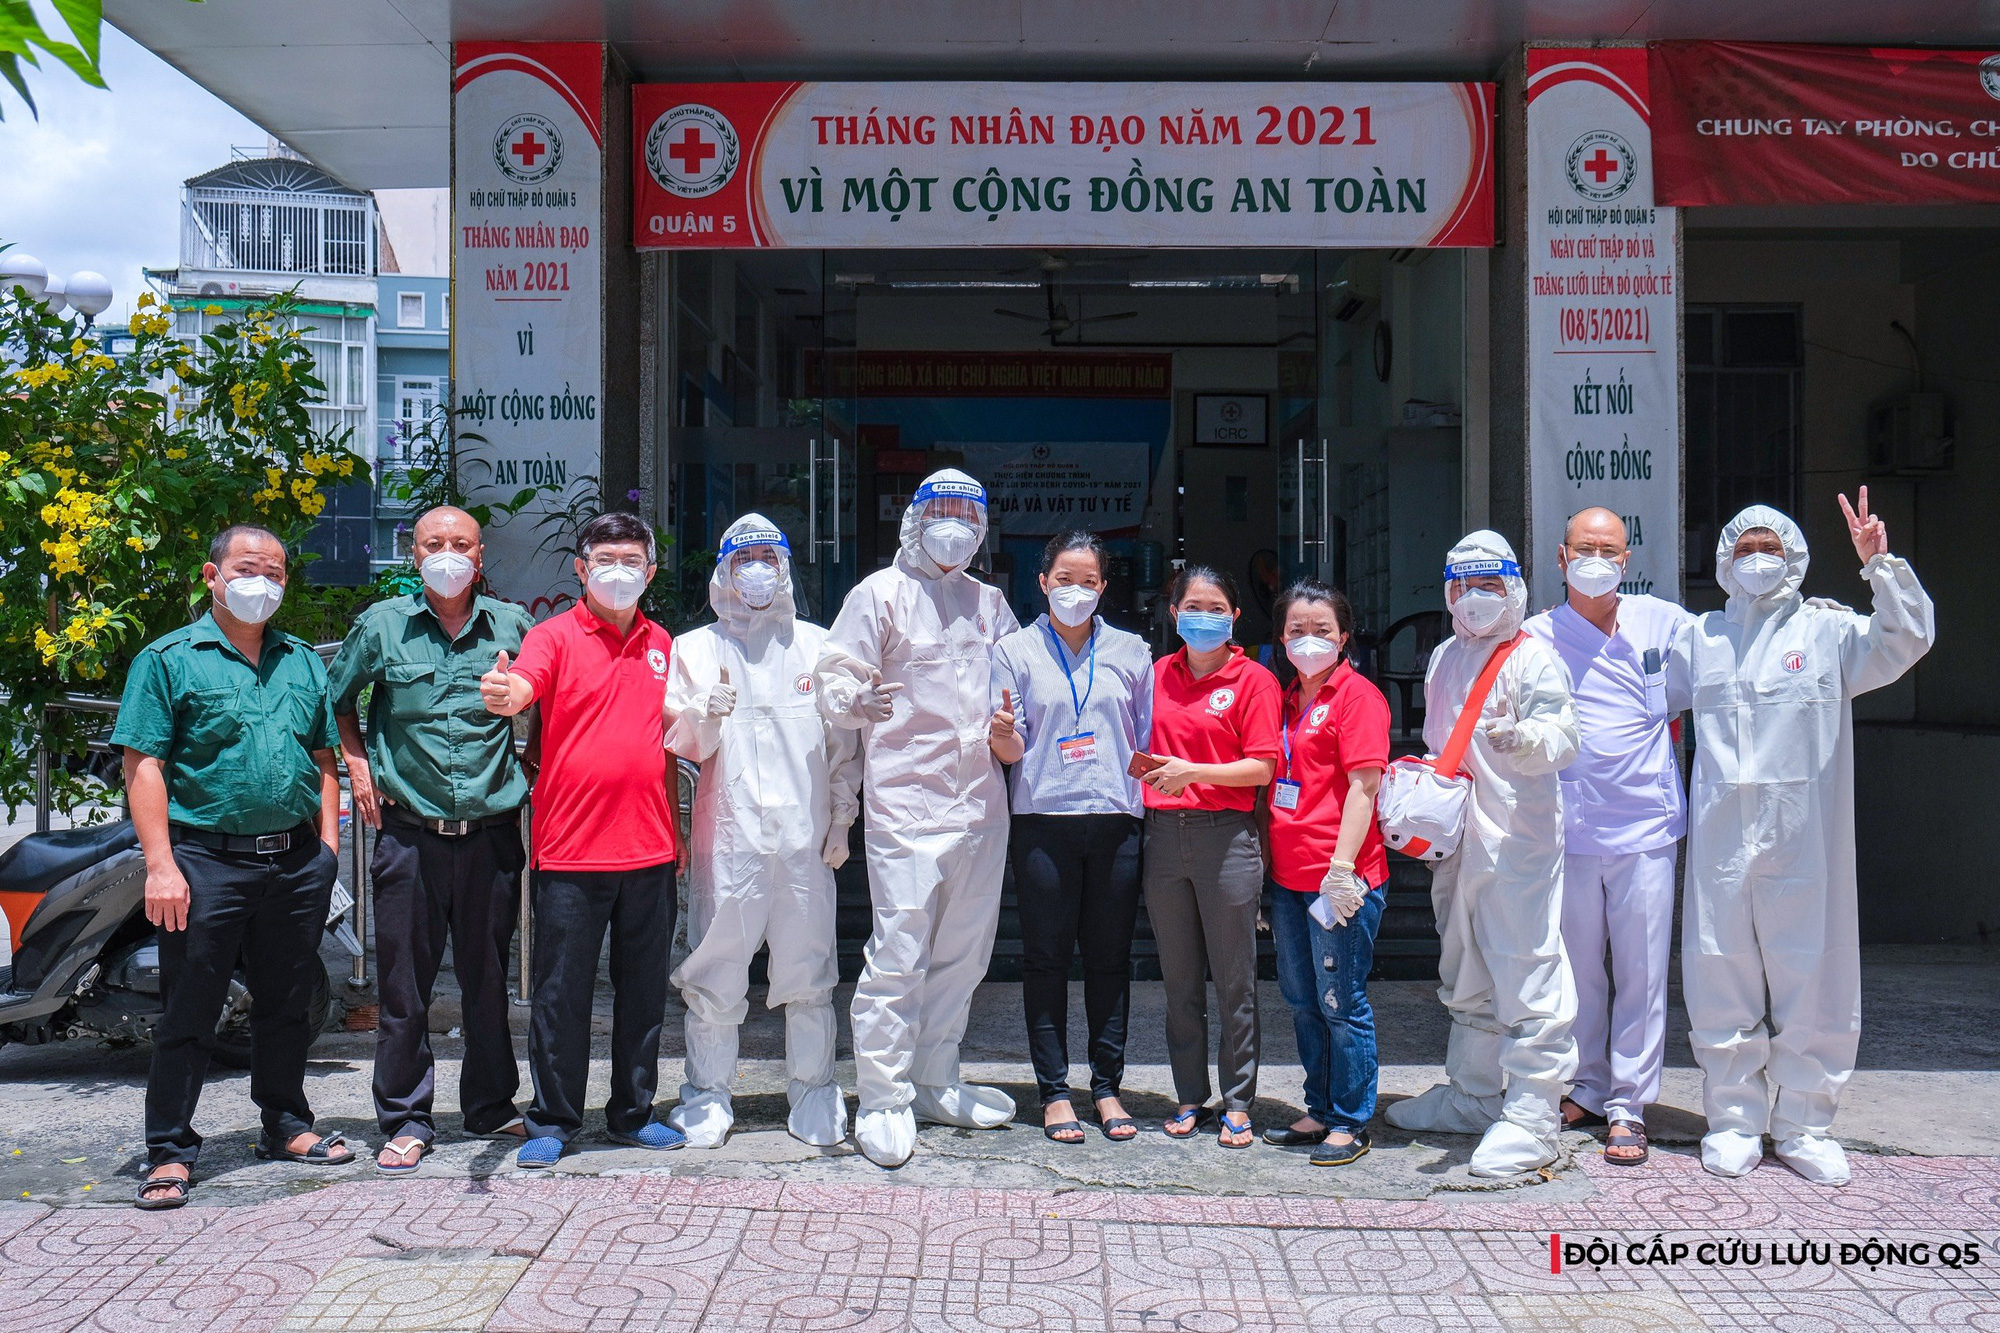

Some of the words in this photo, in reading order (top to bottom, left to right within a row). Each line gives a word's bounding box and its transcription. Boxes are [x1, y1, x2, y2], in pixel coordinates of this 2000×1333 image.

[811, 106, 936, 146] THÁNG
[950, 106, 1056, 145] NHÂN
[1069, 114, 1146, 153] ĐẠO
[1159, 107, 1244, 146] NĂM
[1255, 105, 1378, 147] 2021
[1696, 118, 1793, 136] CHUNG
[1801, 118, 1848, 136] TAY
[1855, 115, 1962, 139] PHÒNG,
[1901, 151, 1939, 168] DO
[470, 188, 486, 211] HỘI
[487, 188, 506, 208] CHỮ
[507, 188, 529, 211] THẬP
[531, 187, 544, 208] ĐỎ
[546, 188, 569, 211] QUẬN
[571, 192, 577, 208] 5
[779, 166, 825, 214] VÌ
[841, 166, 940, 222] MỘT
[952, 166, 1071, 222] CỘNG
[1088, 157, 1215, 213] ĐỒNG
[1229, 176, 1293, 214] AN
[1305, 166, 1428, 214] TOÀN
[649, 211, 714, 237] QUẬN
[722, 215, 737, 233] 5
[1548, 209, 1563, 229] HỘI
[1565, 208, 1584, 225] CHỮ
[1585, 208, 1607, 229] THẬP
[1609, 206, 1622, 225] ĐỎ
[1624, 207, 1648, 228] QUẬN
[1650, 209, 1656, 225] 5
[462, 220, 511, 249] THÁNG
[515, 220, 556, 249] NHÂN
[560, 226, 590, 254] ĐẠO
[1550, 233, 1575, 259] NGÀY
[1577, 233, 1598, 259] CHỮ
[1599, 234, 1624, 264] THẬP
[1626, 231, 1640, 258] ĐỎ
[1641, 232, 1655, 258] VÀ
[485, 263, 519, 291] NĂM
[523, 261, 571, 291] 2021
[1533, 270, 1564, 296] TRĂNG
[1566, 270, 1589, 296] LƯỠI
[1592, 264, 1615, 296] LIỀM
[1617, 266, 1631, 296] ĐỎ
[1633, 263, 1659, 299] QUỐC
[1661, 265, 1673, 296] TẾ
[516, 322, 534, 356] VÌ
[1559, 305, 1650, 345] (08/5/2021)
[851, 360, 884, 390] ỘNG
[888, 359, 913, 387] HÒA
[917, 360, 934, 387] XÃ
[937, 361, 958, 391] HỘI
[961, 358, 986, 387] CHỦ
[989, 361, 1029, 388] NGHĨA
[1032, 361, 1058, 391] VIỆT
[1061, 365, 1091, 388] NAM
[1135, 361, 1165, 389] NĂM
[1573, 367, 1602, 415] KẾT
[1606, 367, 1634, 415] NỐI
[460, 388, 497, 427] MỘT
[501, 388, 545, 427] CỘNG
[549, 381, 596, 421] ĐỒNG
[1214, 427, 1249, 440] ICRC
[495, 459, 519, 485] AN
[522, 452, 567, 485] TOÀN
[1565, 441, 1605, 489] CỘNG
[1610, 433, 1652, 480] ĐỒNG
[958, 485, 980, 494] shield
[1024, 493, 1043, 513] VÀ
[1047, 493, 1075, 516] VẬT
[1078, 495, 1098, 513] TƯ
[1101, 497, 1111, 513] Y
[1114, 491, 1133, 513] TẾ
[735, 534, 753, 543] Face
[756, 532, 779, 540] shield
[1621, 515, 1643, 546] UA
